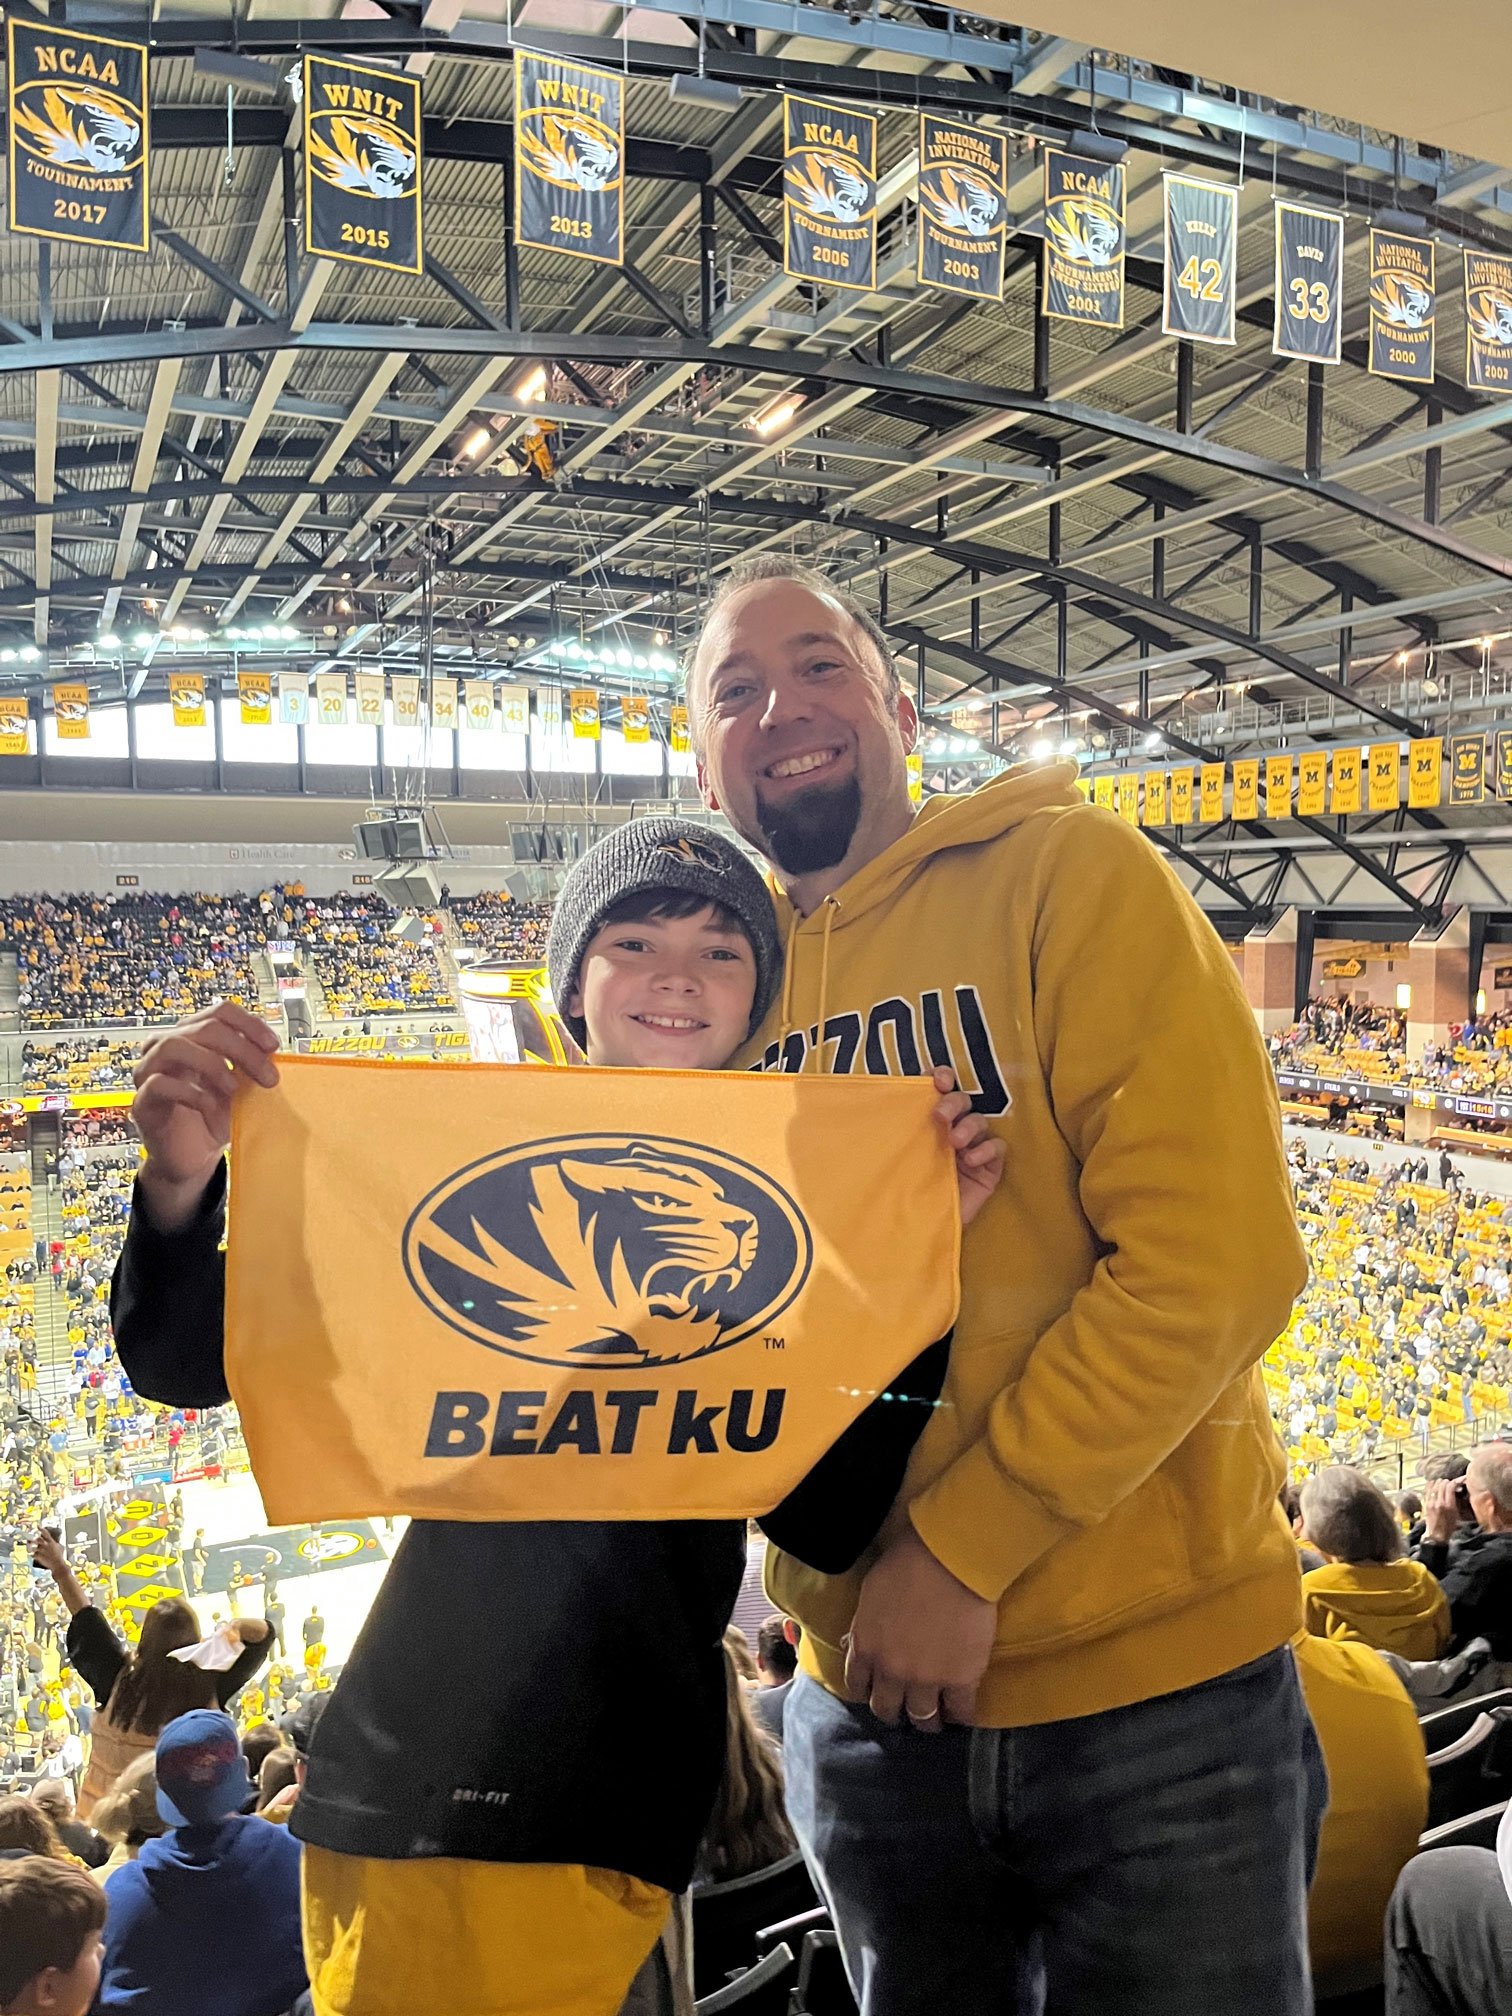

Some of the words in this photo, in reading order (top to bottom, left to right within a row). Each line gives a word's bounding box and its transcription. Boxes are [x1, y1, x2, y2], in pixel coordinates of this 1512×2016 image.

[34, 46, 120, 87] NCAA
[322, 83, 403, 122] WNIT
[536, 78, 606, 114] WNIT
[804, 122, 859, 154] NCAA
[933, 130, 992, 158] NATIONAL
[927, 144, 1000, 175] INVITATION
[26, 158, 134, 193] TOURNAMENT
[1061, 171, 1111, 200] NCAA
[53, 199, 107, 225] 2017
[340, 223, 390, 250] 2015
[549, 214, 593, 239] 2013
[793, 212, 869, 243] TOURNAMENT
[927, 226, 999, 254] TOURNAMENT
[812, 245, 849, 269] 2006
[1378, 243, 1422, 263] NATIONAL
[943, 258, 980, 281] 2003
[1053, 257, 1120, 283] TOURNAMENT
[1376, 255, 1429, 277] INVITATION
[1177, 255, 1224, 303] 42
[1288, 277, 1330, 324] 33
[1377, 322, 1430, 344] TOURNAMENT
[1389, 348, 1416, 365] 2000
[289, 697, 298, 711] 3
[323, 698, 341, 712] 20
[362, 699, 380, 713] 22
[398, 702, 417, 715] 30
[435, 702, 452, 716] 34
[471, 704, 490, 719] 40
[1376, 763, 1391, 777] M
[1417, 758, 1432, 773] M
[1459, 753, 1477, 771] M
[1240, 777, 1251, 790] M
[1273, 774, 1284, 787] M
[1306, 770, 1319, 783] M
[1340, 767, 1353, 780] M
[1151, 787, 1160, 798] M
[1177, 784, 1187, 796] M
[1206, 781, 1217, 792] M
[242, 851, 271, 859] Health
[273, 850, 295, 859] Care
[309, 1036, 386, 1053] MIZZOU
[763, 1337, 786, 1350] TM
[423, 1390, 659, 1458] BEAT
[666, 1388, 787, 1455] kU
